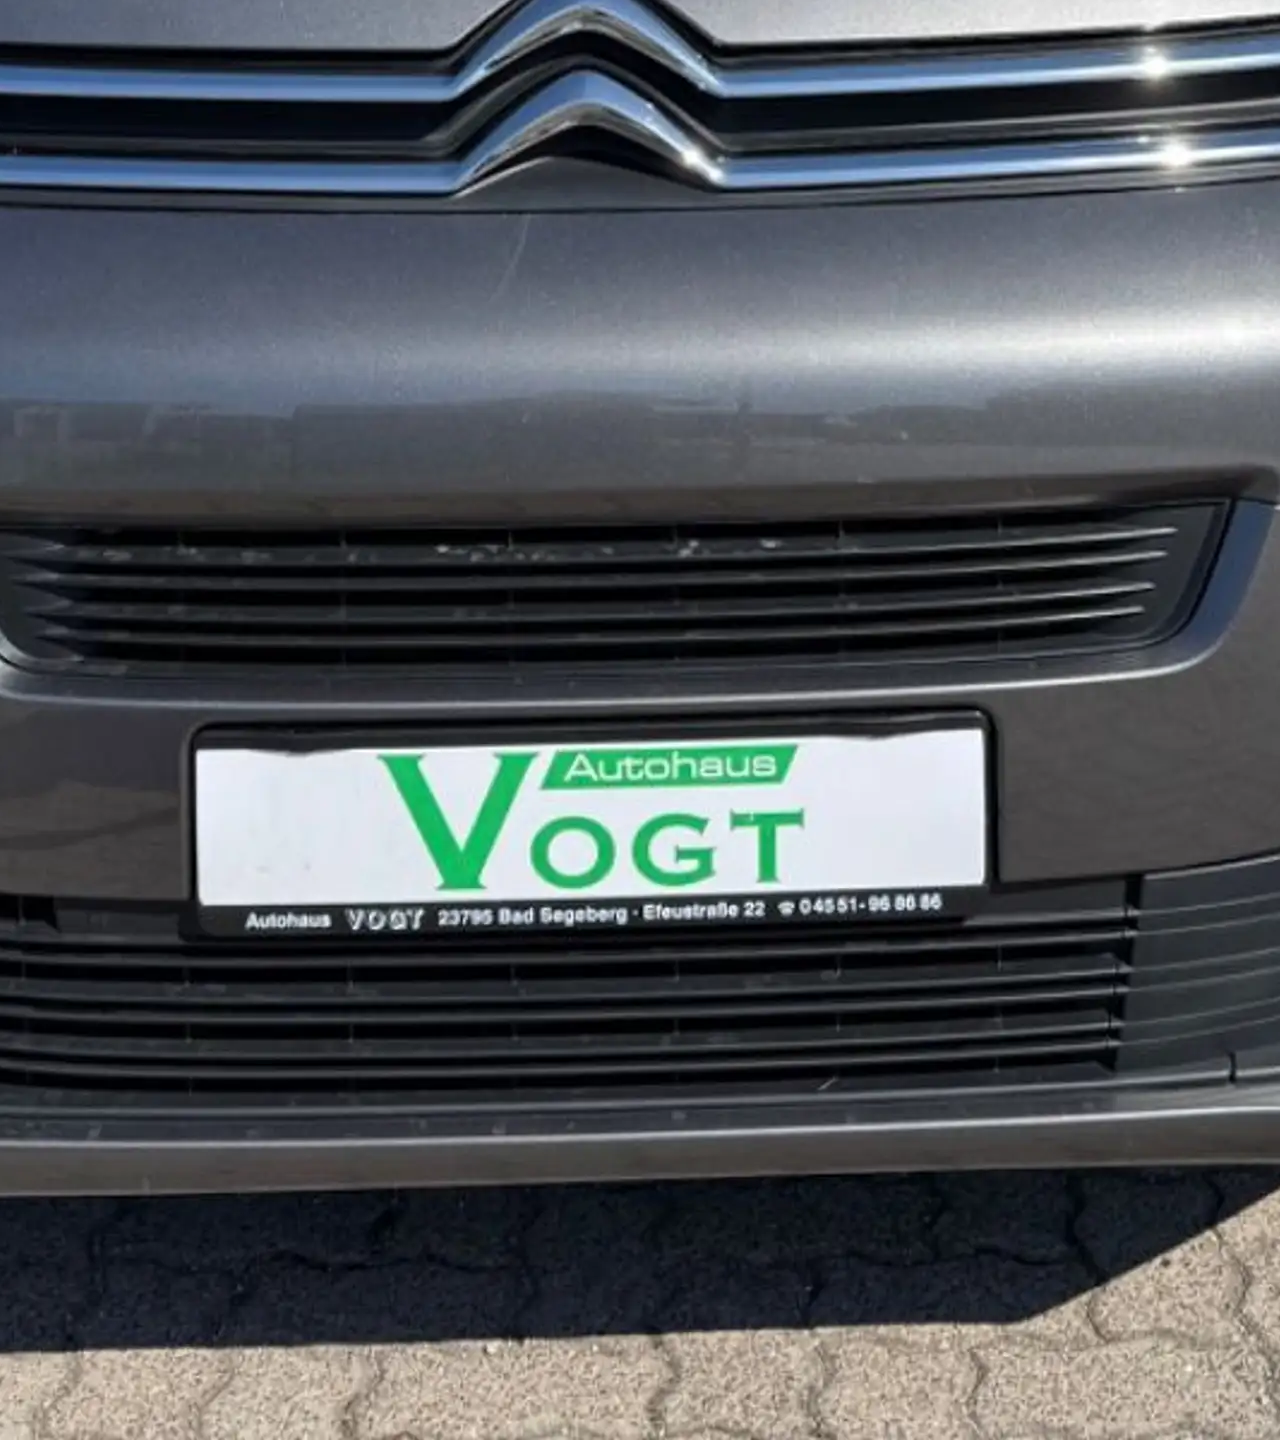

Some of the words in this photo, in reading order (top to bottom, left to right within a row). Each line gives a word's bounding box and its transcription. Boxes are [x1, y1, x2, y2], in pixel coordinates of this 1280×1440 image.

[563, 750, 777, 782] Autohaus
[376, 751, 805, 891] VOGT
[244, 911, 332, 931] Autohaus
[345, 907, 426, 931] VOGT
[498, 906, 534, 925] Bad
[540, 905, 628, 927] Segeberg
[642, 901, 739, 921] Efeustraße
[743, 900, 765, 918] 22
